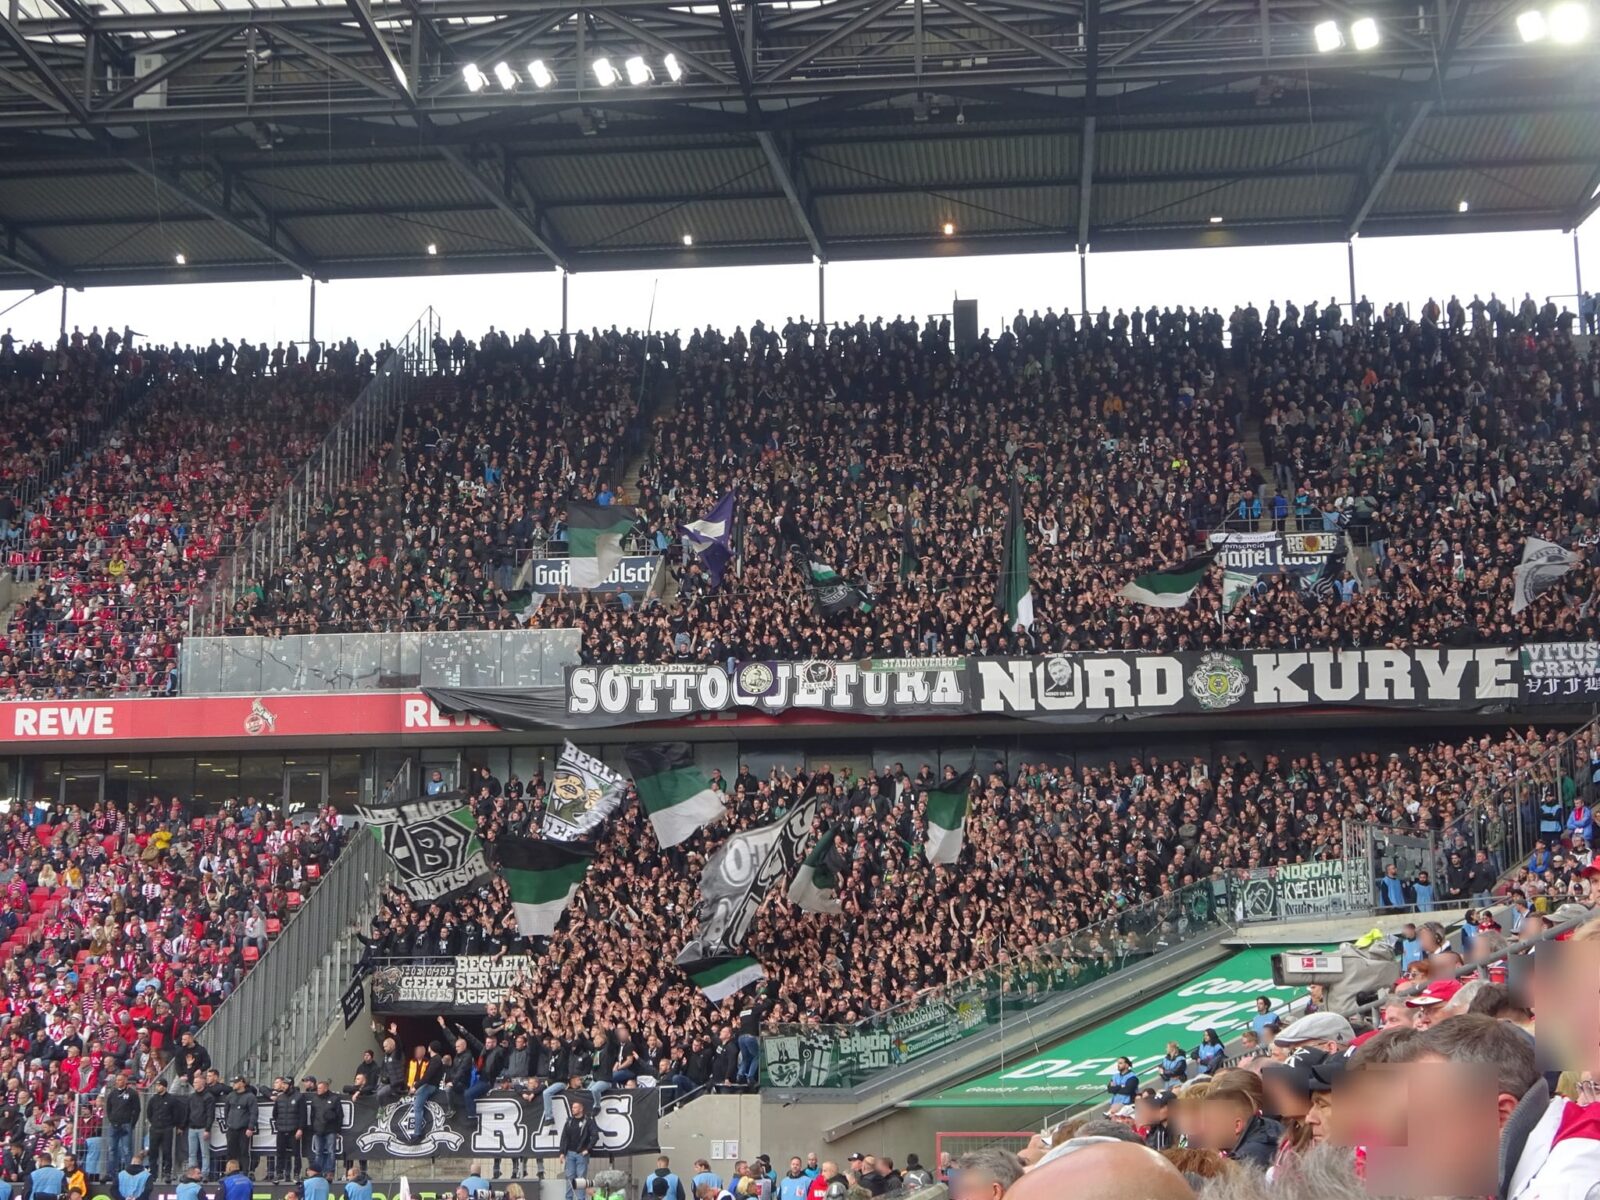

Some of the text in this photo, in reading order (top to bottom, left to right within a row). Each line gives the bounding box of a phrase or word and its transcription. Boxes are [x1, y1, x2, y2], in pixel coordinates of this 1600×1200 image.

[1525, 642, 1598, 660] VITUS
[978, 656, 1184, 711] NORD
[1253, 648, 1519, 703] KURVE
[1530, 660, 1597, 677] CREW
[14, 706, 114, 736] REWE
